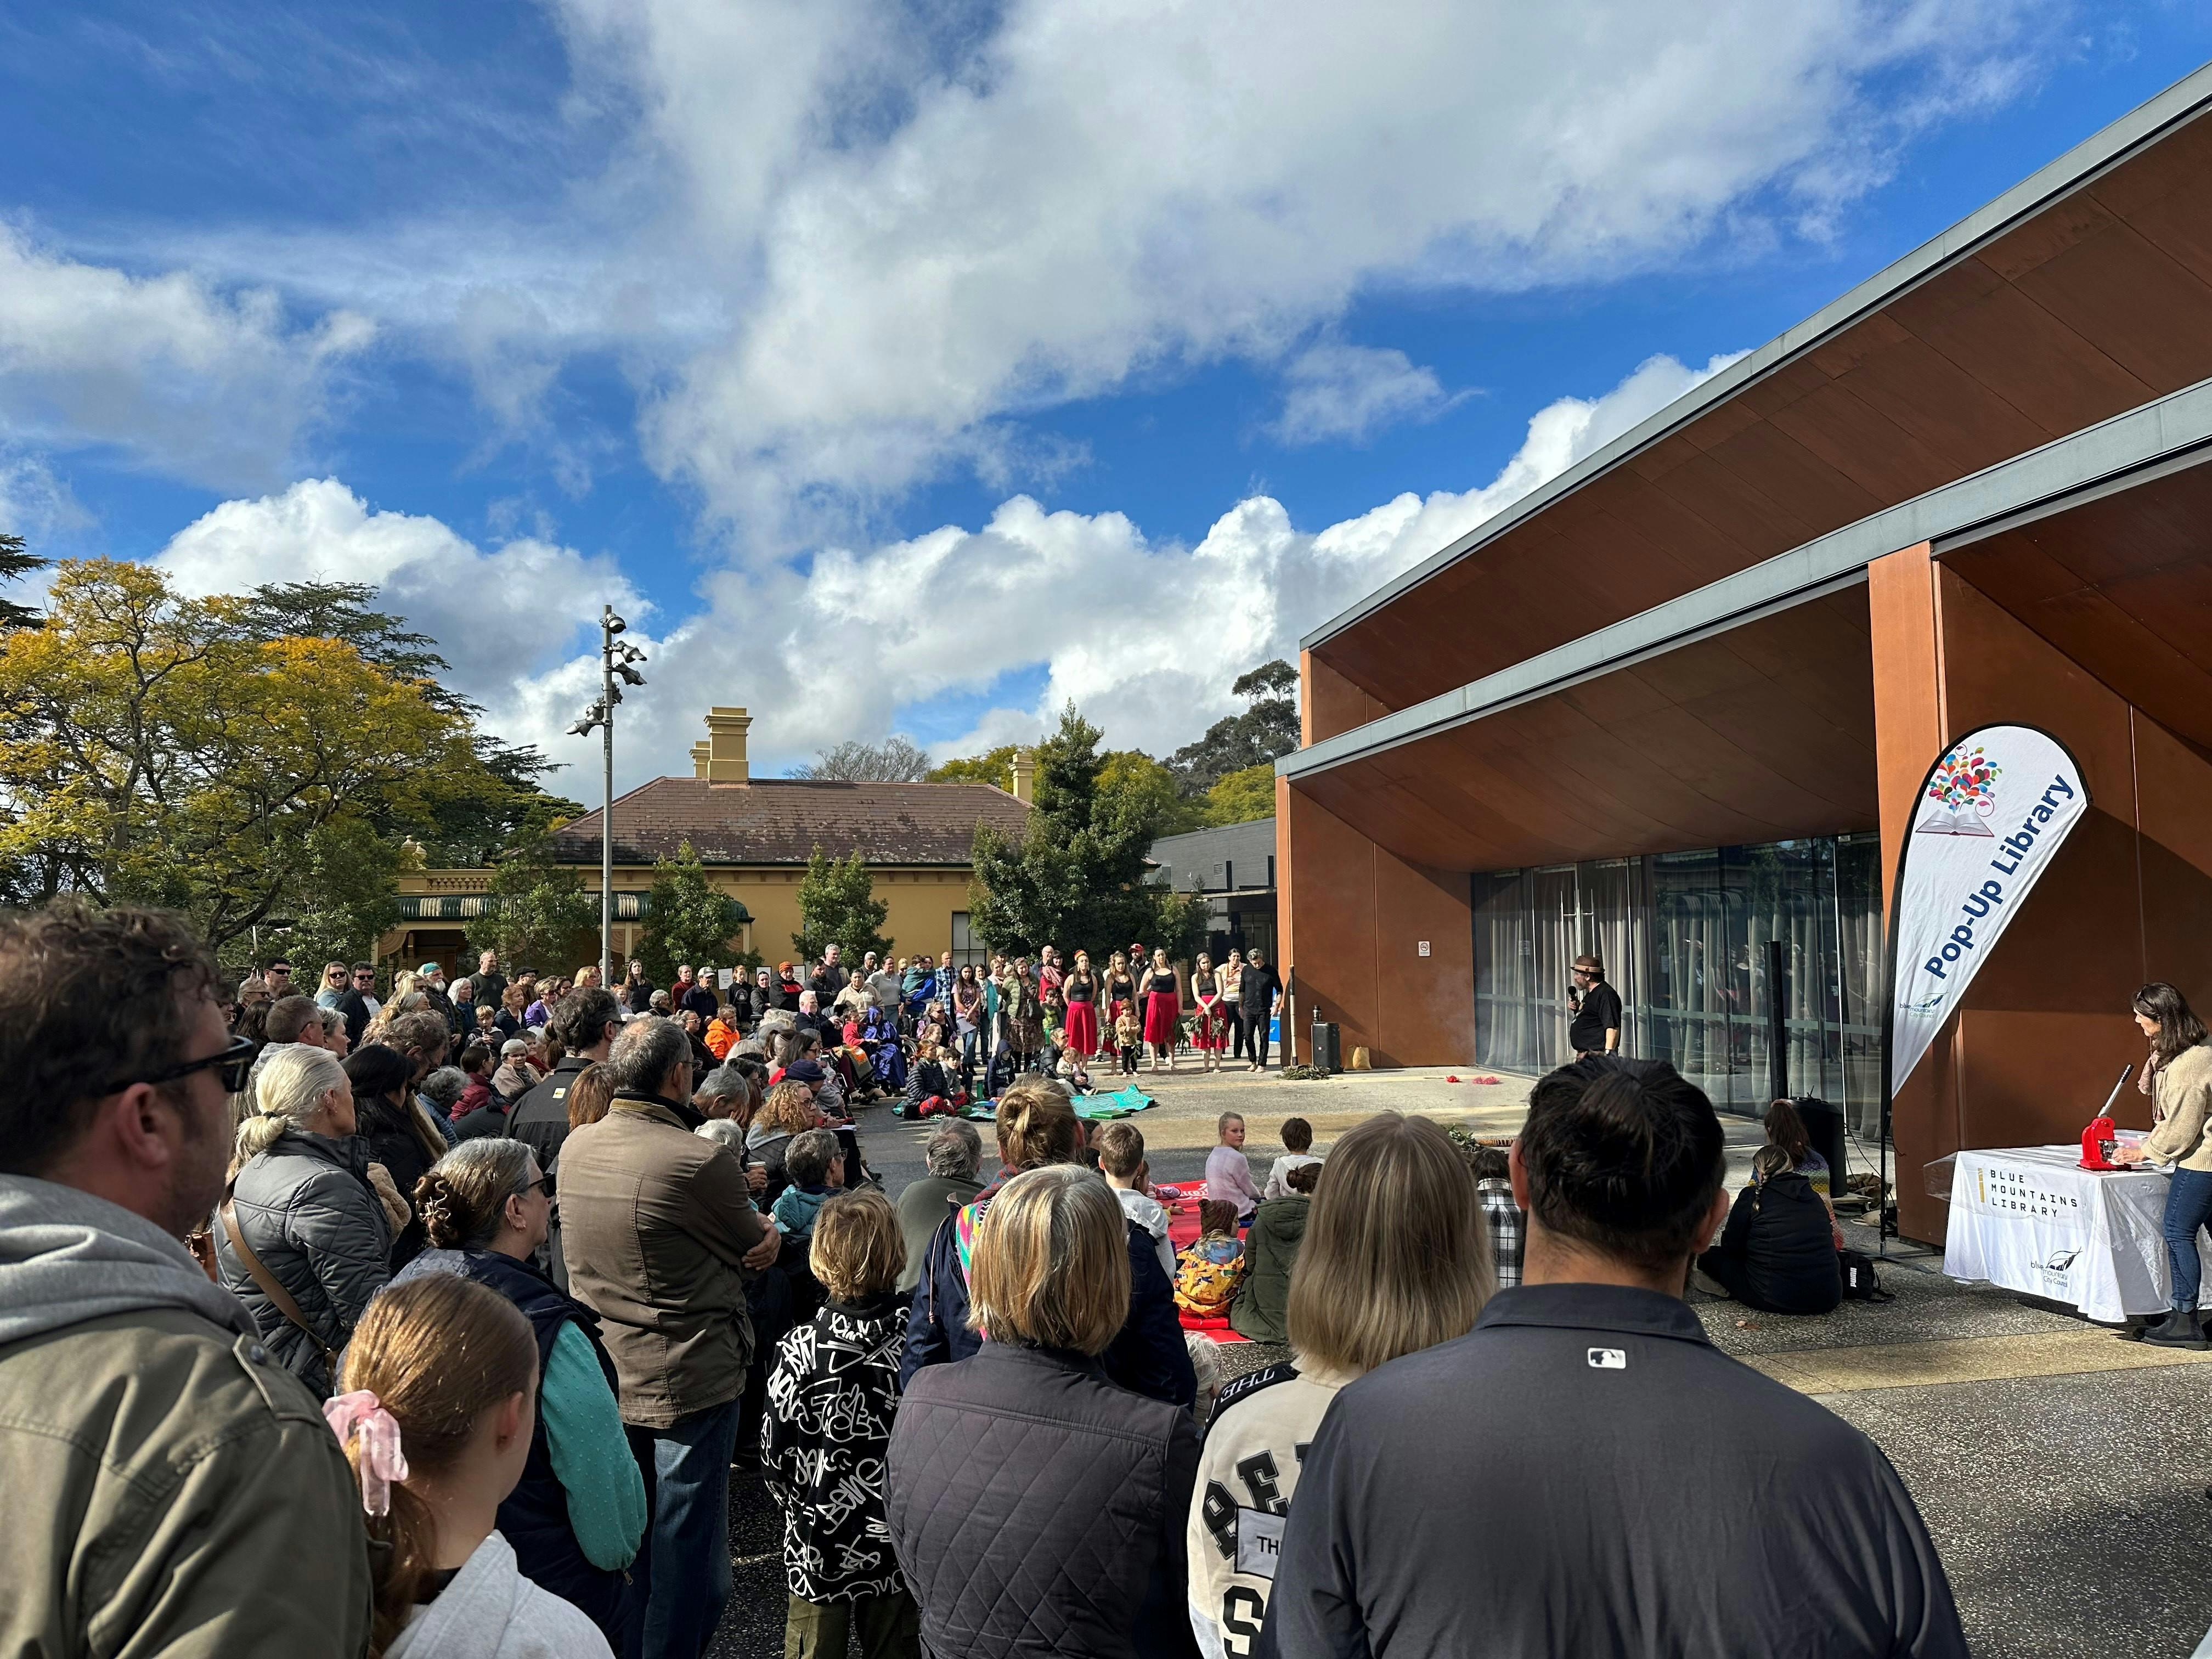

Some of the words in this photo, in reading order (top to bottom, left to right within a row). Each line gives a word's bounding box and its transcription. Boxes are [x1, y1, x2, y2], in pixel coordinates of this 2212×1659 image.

[1924, 881, 2003, 979] Pop-Up
[1990, 774, 2074, 876] Library
[1990, 1169, 2024, 1183] BLUE
[1991, 1184, 2077, 1207] MOUNTAINS
[1993, 1198, 2057, 1217] LIBRARY
[1221, 1368, 1275, 1403] THE
[1257, 1536, 1282, 1556] TH
